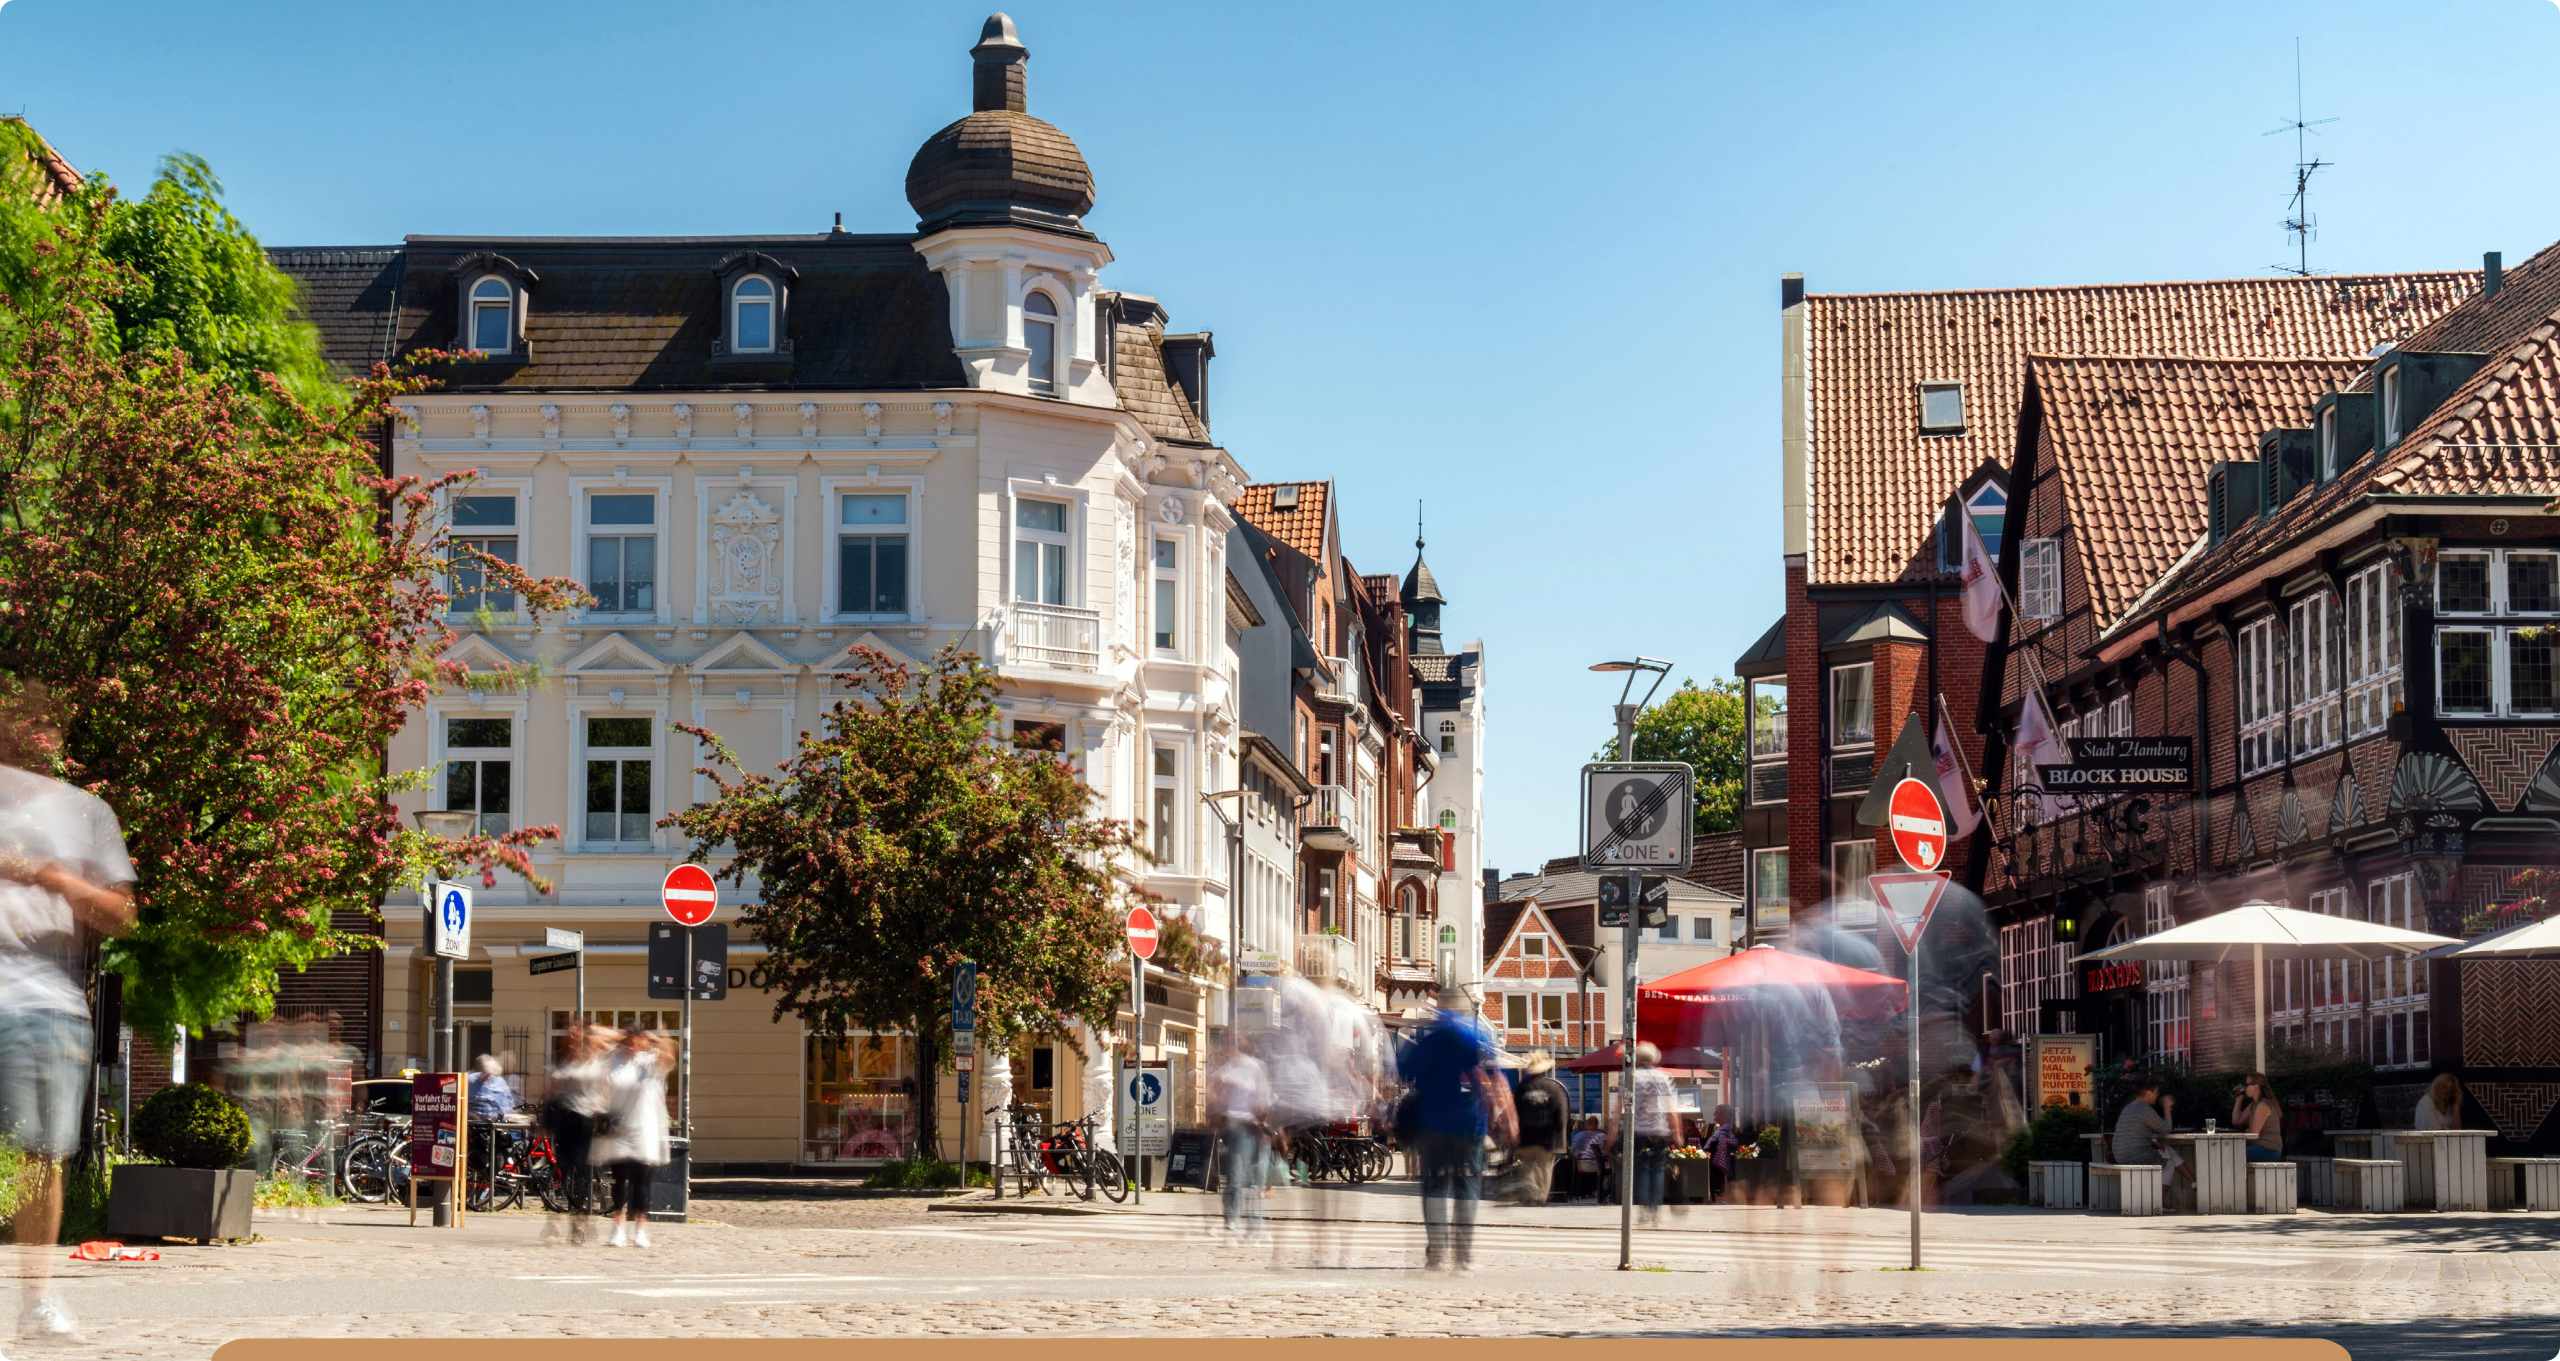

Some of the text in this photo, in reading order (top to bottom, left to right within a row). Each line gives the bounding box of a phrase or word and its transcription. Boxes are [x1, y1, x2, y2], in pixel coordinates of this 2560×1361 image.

[2079, 740, 2188, 762] Stadt Hamburg
[2048, 767, 2188, 784] BLOCK HOUSE
[1644, 989, 1669, 999] BEST
[2042, 1047, 2072, 1055] JETZT
[2042, 1064, 2064, 1072] MAL
[2042, 1072, 2082, 1080] WIEDER
[414, 1094, 451, 1104] Vorfahrt für
[414, 1103, 456, 1112] Bus und Bahn
